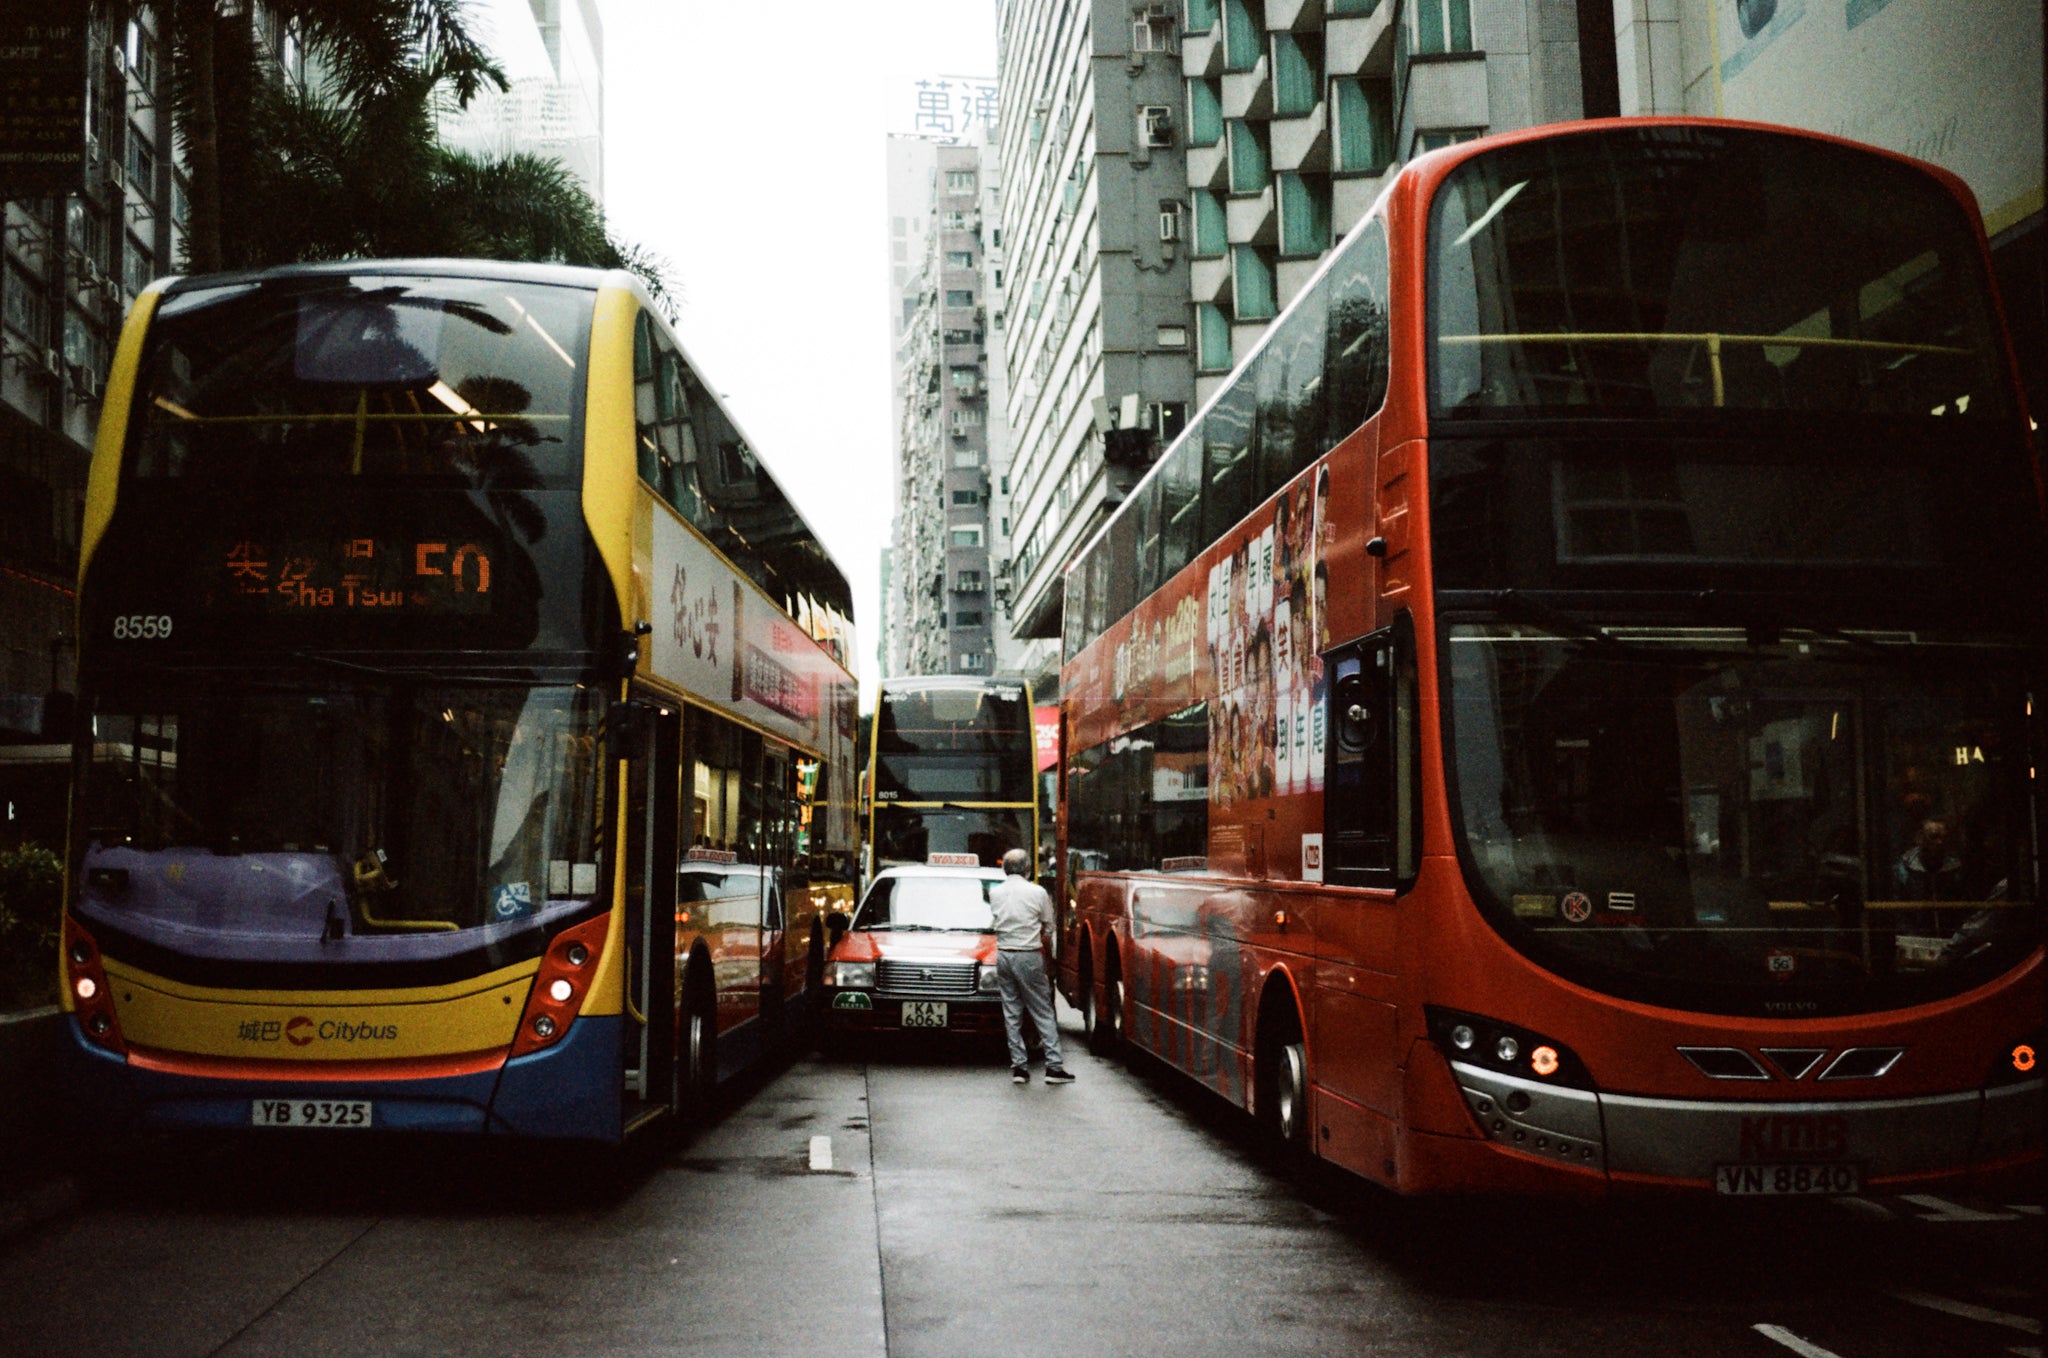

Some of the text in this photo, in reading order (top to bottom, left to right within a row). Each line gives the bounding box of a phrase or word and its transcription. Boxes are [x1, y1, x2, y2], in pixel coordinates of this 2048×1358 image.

[277, 580, 335, 607] Sha
[113, 615, 173, 640] 8559
[878, 791, 899, 799] 8015
[932, 854, 976, 865] TAXI
[914, 1002, 935, 1015] KA
[1763, 1001, 1818, 1011] VOLVO
[905, 1014, 944, 1027] 6063
[237, 1020, 282, 1042] 城巴
[318, 1020, 398, 1042] Citybus
[262, 1101, 365, 1125] YB 9325
[1725, 1166, 1851, 1193] VN 8840
